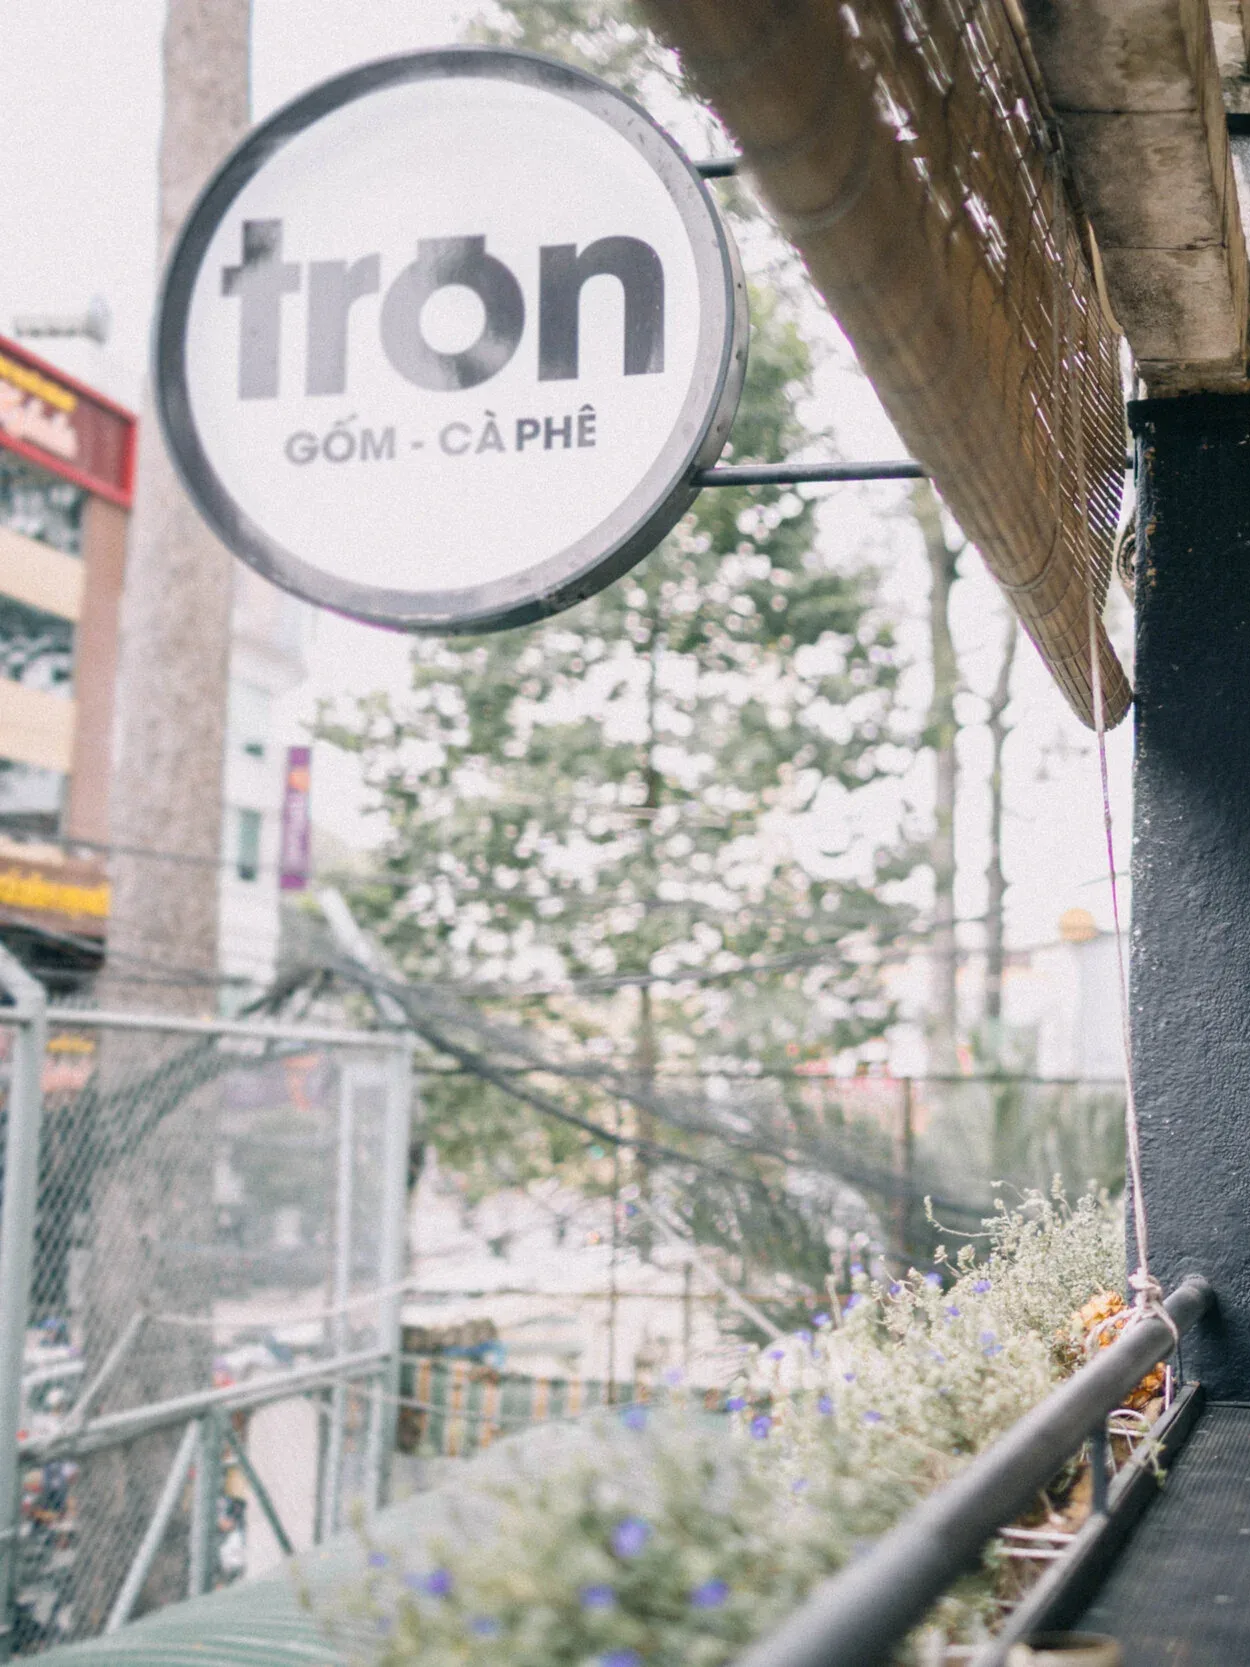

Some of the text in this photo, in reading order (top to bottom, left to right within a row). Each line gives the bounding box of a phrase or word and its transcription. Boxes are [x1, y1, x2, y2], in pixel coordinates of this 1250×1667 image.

[284, 413, 397, 466] GỐM
[438, 409, 506, 456] CÀ
[515, 404, 597, 452] PHÊ
